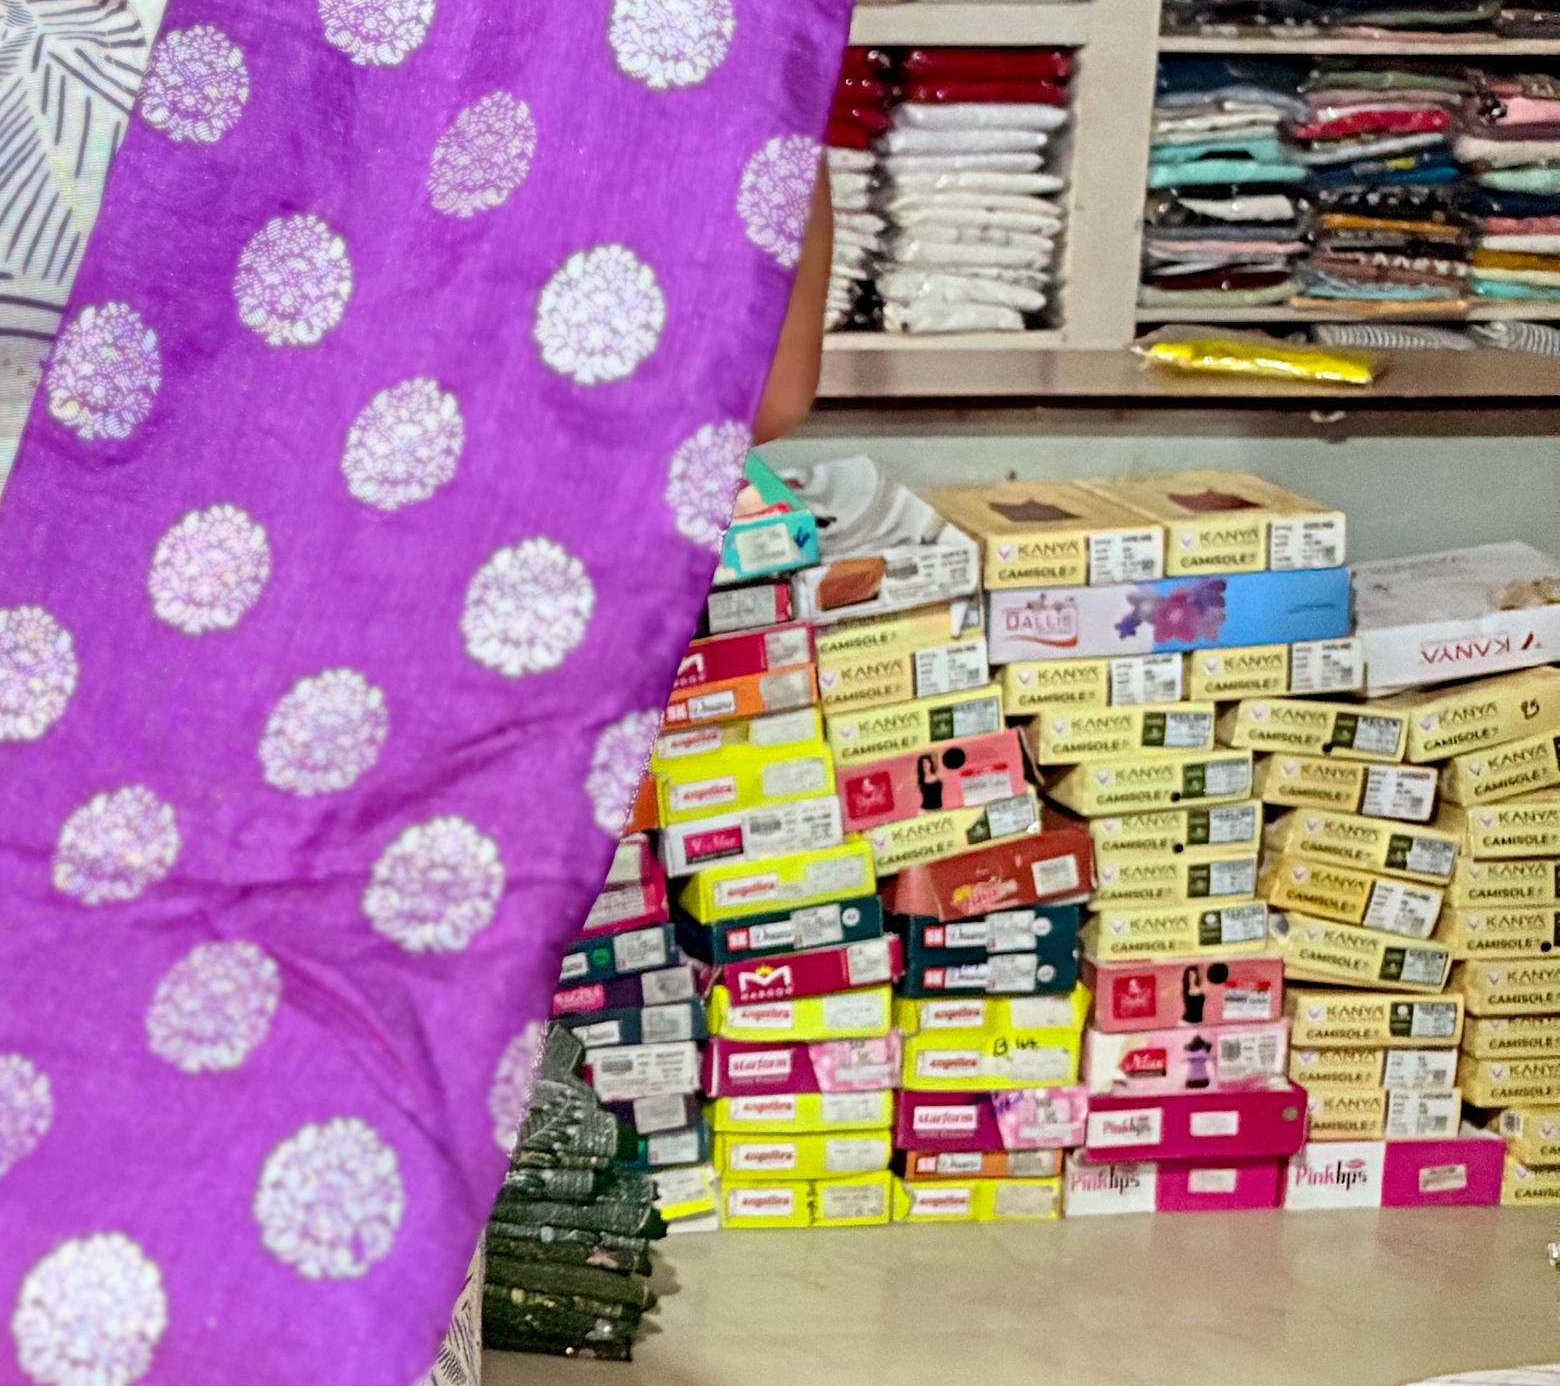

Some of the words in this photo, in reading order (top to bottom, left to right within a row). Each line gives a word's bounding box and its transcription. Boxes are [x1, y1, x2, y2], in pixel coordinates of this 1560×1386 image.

[1200, 528, 1258, 545] KANYA
[1020, 541, 1080, 555] KANYA
[1421, 636, 1510, 664] KANYA
[841, 658, 901, 680] KANYA
[1225, 653, 1282, 670] KANYA
[1039, 668, 1099, 682] KANYA
[1270, 707, 1327, 725] KANYA
[1438, 702, 1498, 723] KANYA
[859, 711, 918, 733] KANYA
[1071, 716, 1132, 731] KANYA
[1488, 744, 1548, 769] KANYA
[1116, 766, 1174, 781] KANYA
[1301, 759, 1357, 780] KANYA
[1121, 815, 1179, 828] KANYA
[1499, 810, 1559, 823] KANYA
[893, 816, 954, 841] KANYA
[1325, 822, 1378, 841] KANYA
[1120, 864, 1177, 878] KANYA
[1488, 864, 1547, 877] KANYA
[1312, 873, 1365, 893] KANYA
[1130, 916, 1188, 931] KANYA
[1486, 914, 1545, 927] KANYA
[1324, 932, 1379, 950] KANYA
[1327, 1005, 1384, 1017] KANYA
[1324, 1098, 1380, 1110] KANYA
